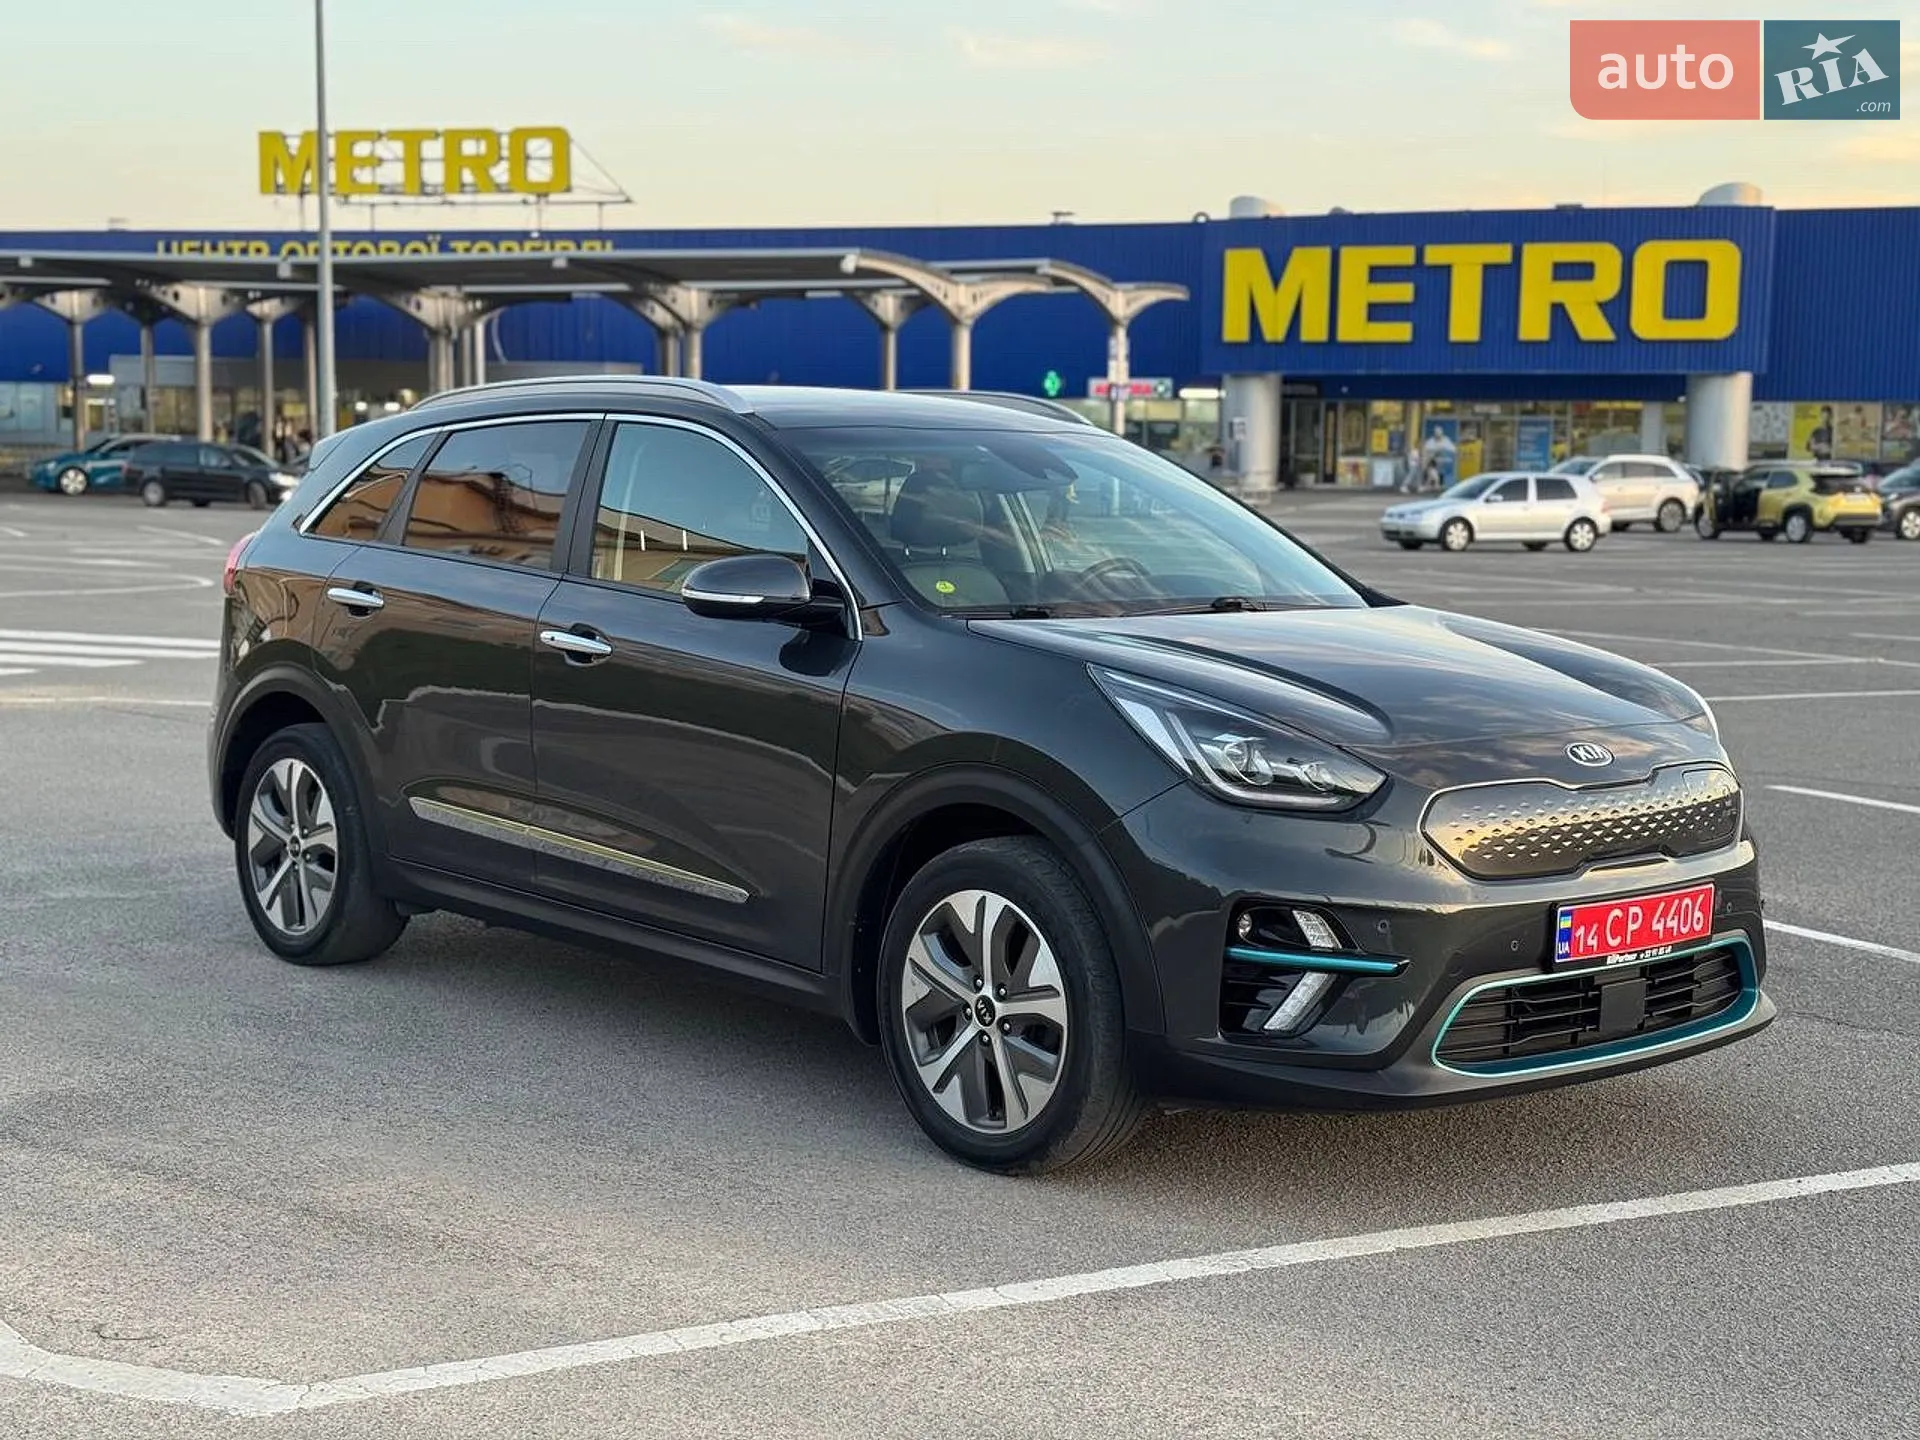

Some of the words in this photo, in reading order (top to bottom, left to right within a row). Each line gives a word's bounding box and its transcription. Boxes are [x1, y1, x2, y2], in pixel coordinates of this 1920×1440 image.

[258, 127, 571, 195] METRO
[1222, 239, 1742, 343] METRO
[1558, 942, 1571, 955] UA
[1575, 923, 1598, 953] 14
[1605, 906, 1643, 947] CP
[1651, 893, 1705, 940] 4406
